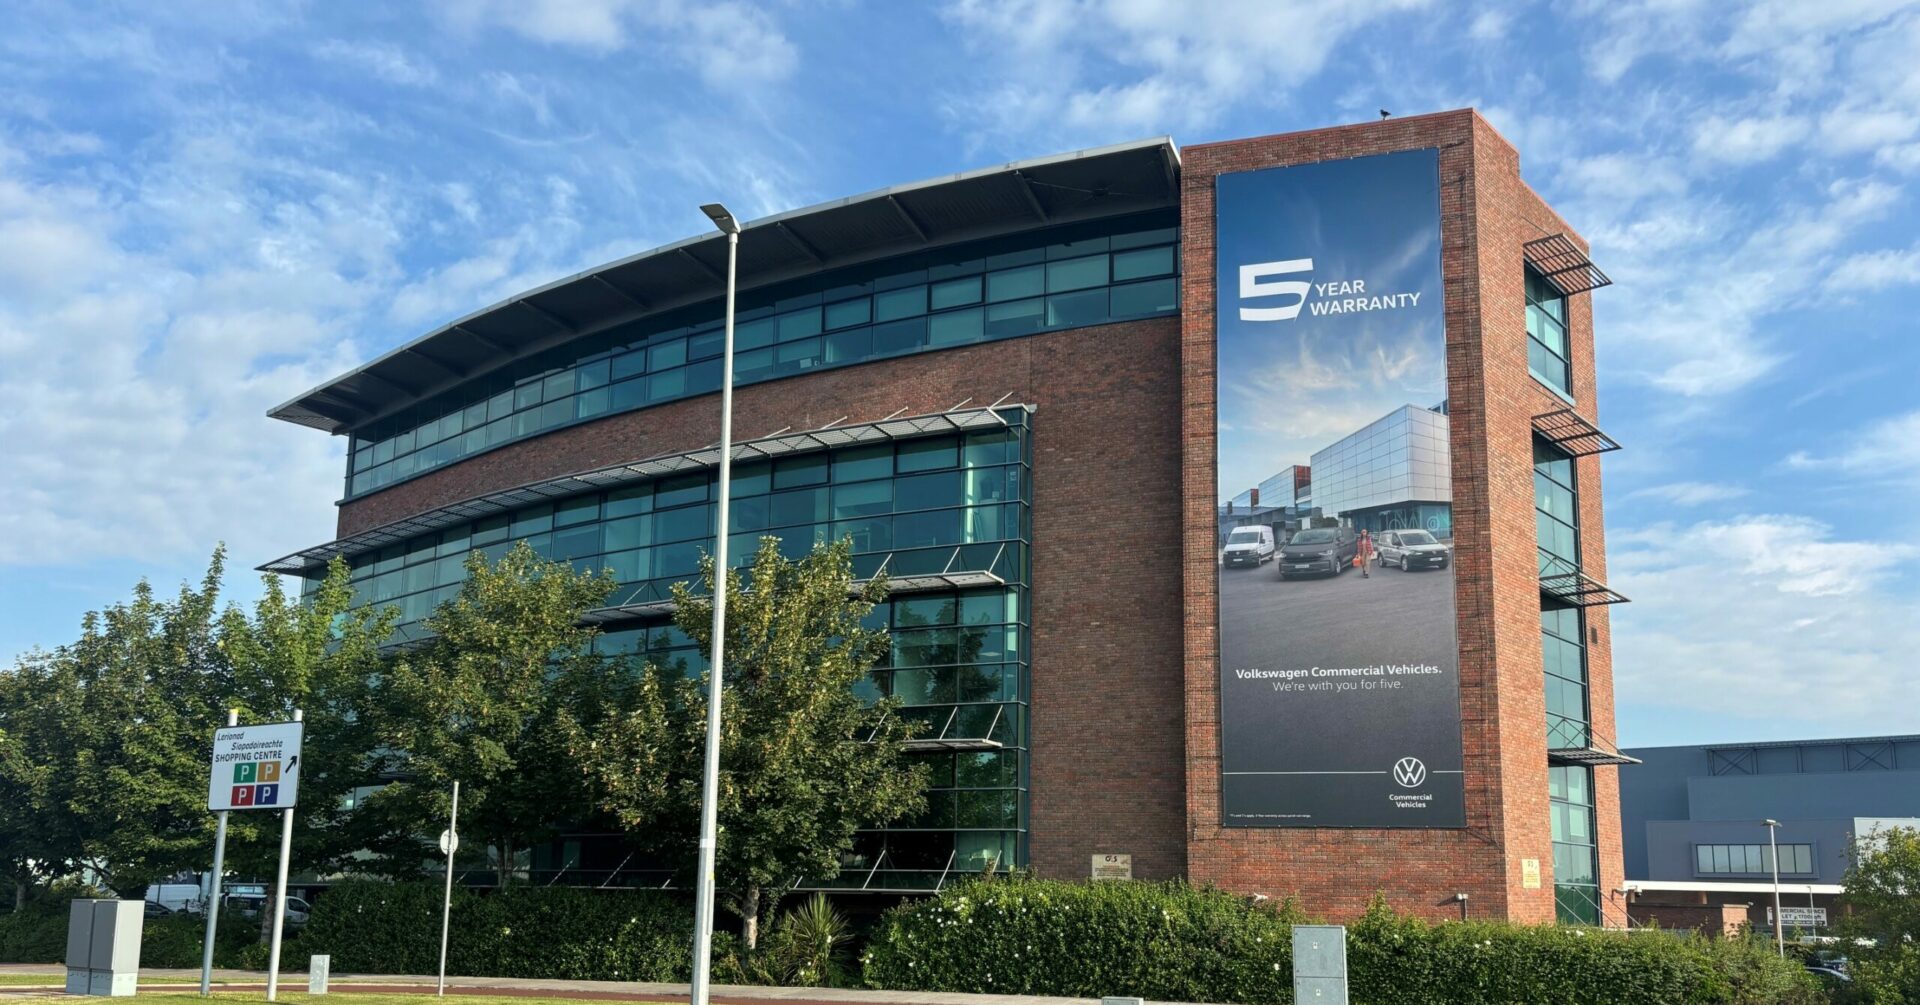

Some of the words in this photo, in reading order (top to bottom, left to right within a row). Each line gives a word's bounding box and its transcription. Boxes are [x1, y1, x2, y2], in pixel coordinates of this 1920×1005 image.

[1239, 257, 1314, 323] 5
[1315, 279, 1366, 297] YEAR
[1309, 292, 1422, 317] WARRANTY
[1235, 668, 1308, 680] Volkswagen
[1311, 665, 1384, 677] Commercial
[1386, 663, 1442, 675] Vehicles.
[1272, 681, 1305, 692] We're
[1308, 680, 1333, 691] with
[1336, 681, 1357, 693] you
[1361, 679, 1376, 690] for
[1380, 678, 1404, 689] five.
[215, 752, 251, 763] SHOPPING
[253, 750, 282, 761] CENTRE
[241, 765, 249, 781] P
[265, 764, 273, 780] P
[238, 788, 247, 804] P
[262, 786, 271, 803] P
[1389, 793, 1432, 801] Commercial
